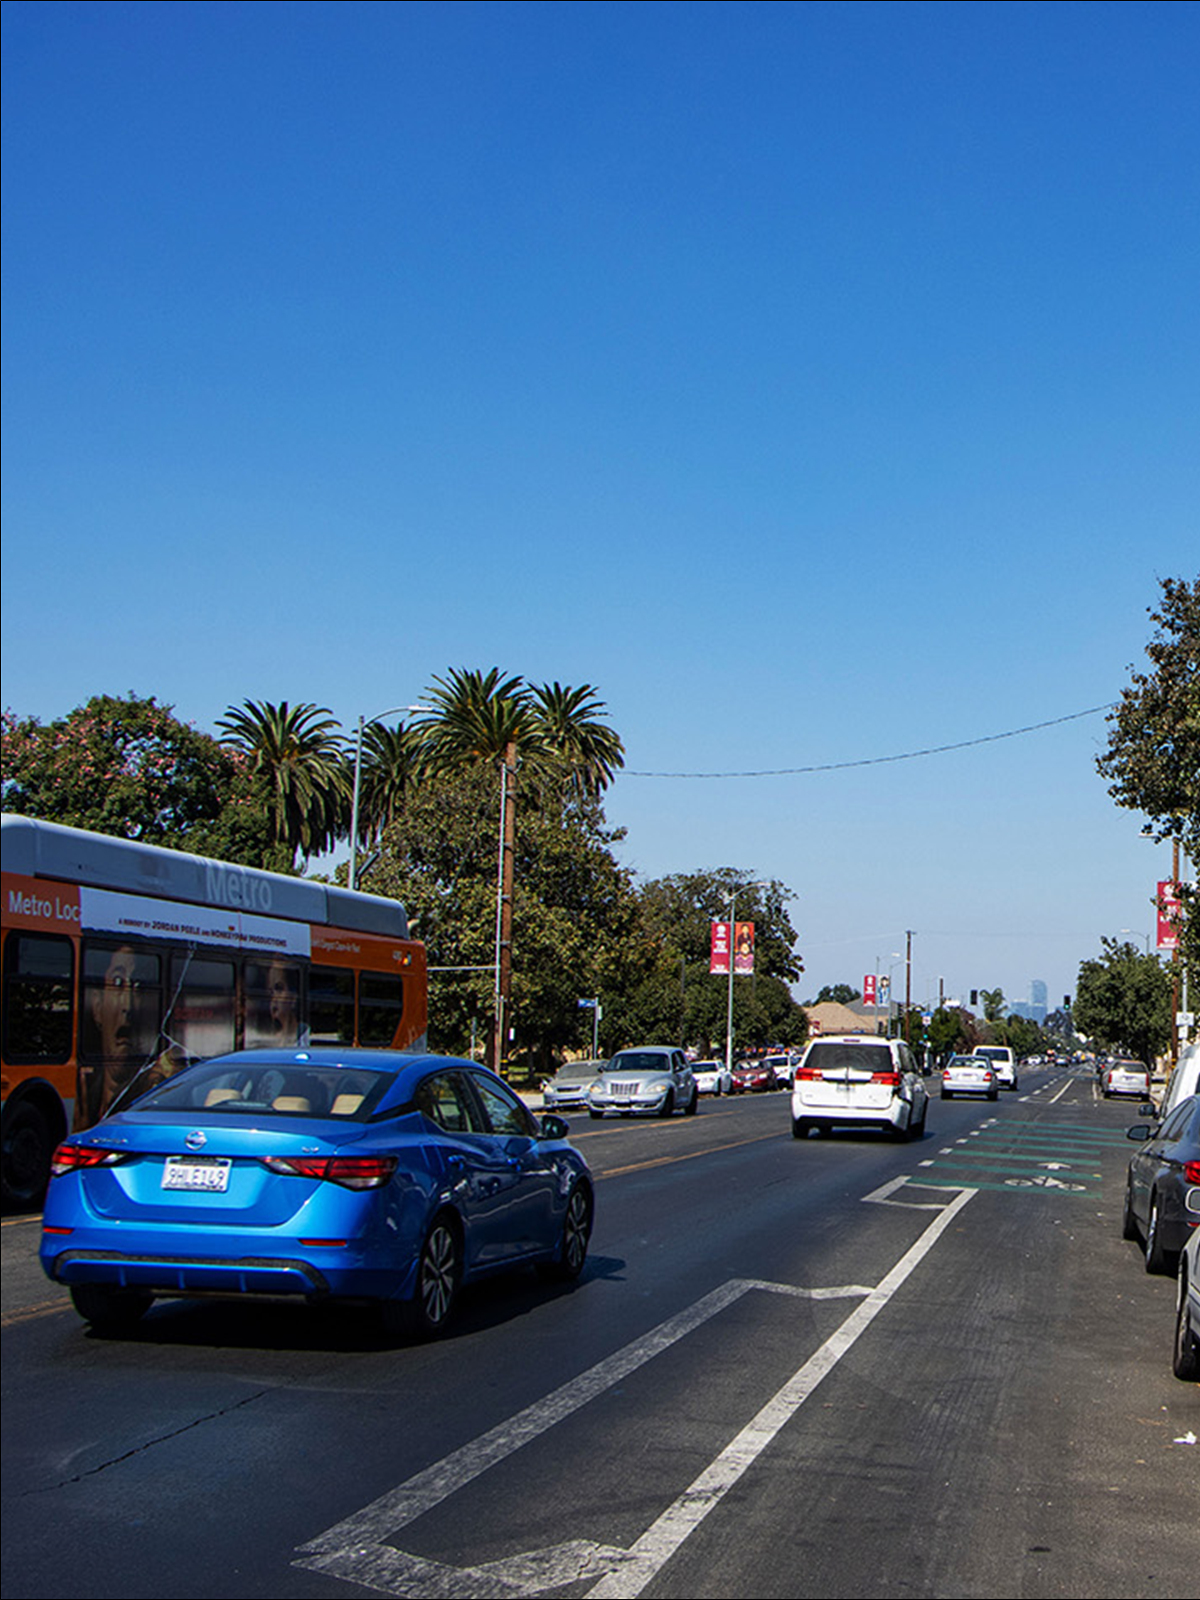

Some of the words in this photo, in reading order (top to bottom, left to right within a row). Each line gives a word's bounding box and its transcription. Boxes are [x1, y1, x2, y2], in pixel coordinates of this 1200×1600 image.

[206, 867, 272, 911] Metro
[9, 890, 52, 918] Metro
[152, 920, 179, 932] JORDAN
[181, 924, 200, 935] PEELE
